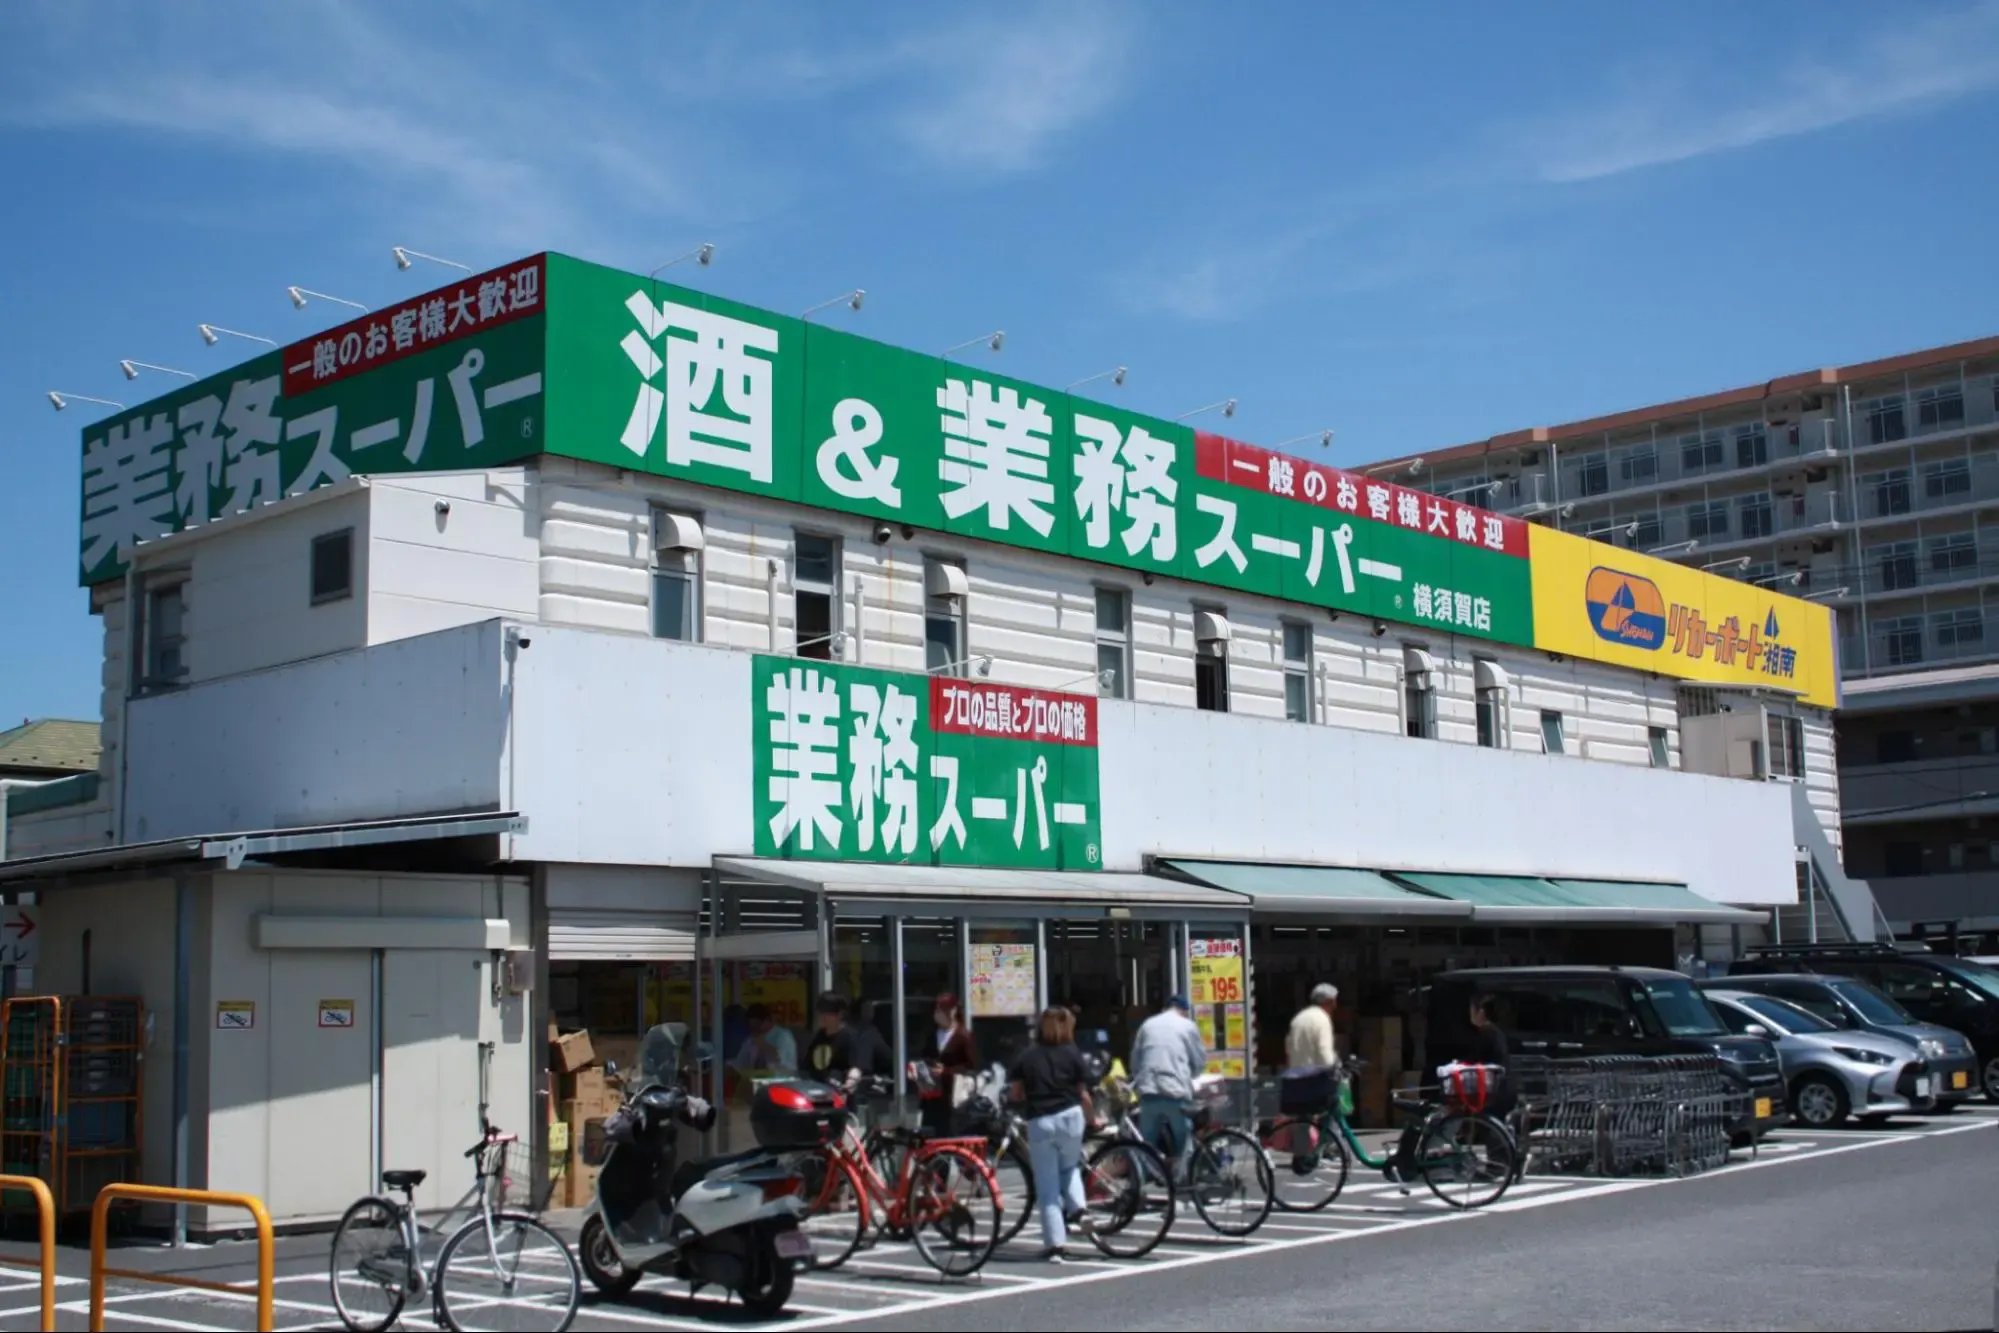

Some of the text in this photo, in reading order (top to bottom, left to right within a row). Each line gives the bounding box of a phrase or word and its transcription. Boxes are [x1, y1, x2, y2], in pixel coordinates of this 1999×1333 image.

[288, 265, 539, 381] 一般のお客様大歓迎
[1232, 456, 1504, 552] 一般のお客様大歓迎
[1413, 582, 1491, 632] 横須賀店
[943, 686, 1087, 741] プロの品質とプロの価格
[767, 668, 1087, 855] 業務スーパー
[1210, 976, 1238, 1001] 195
